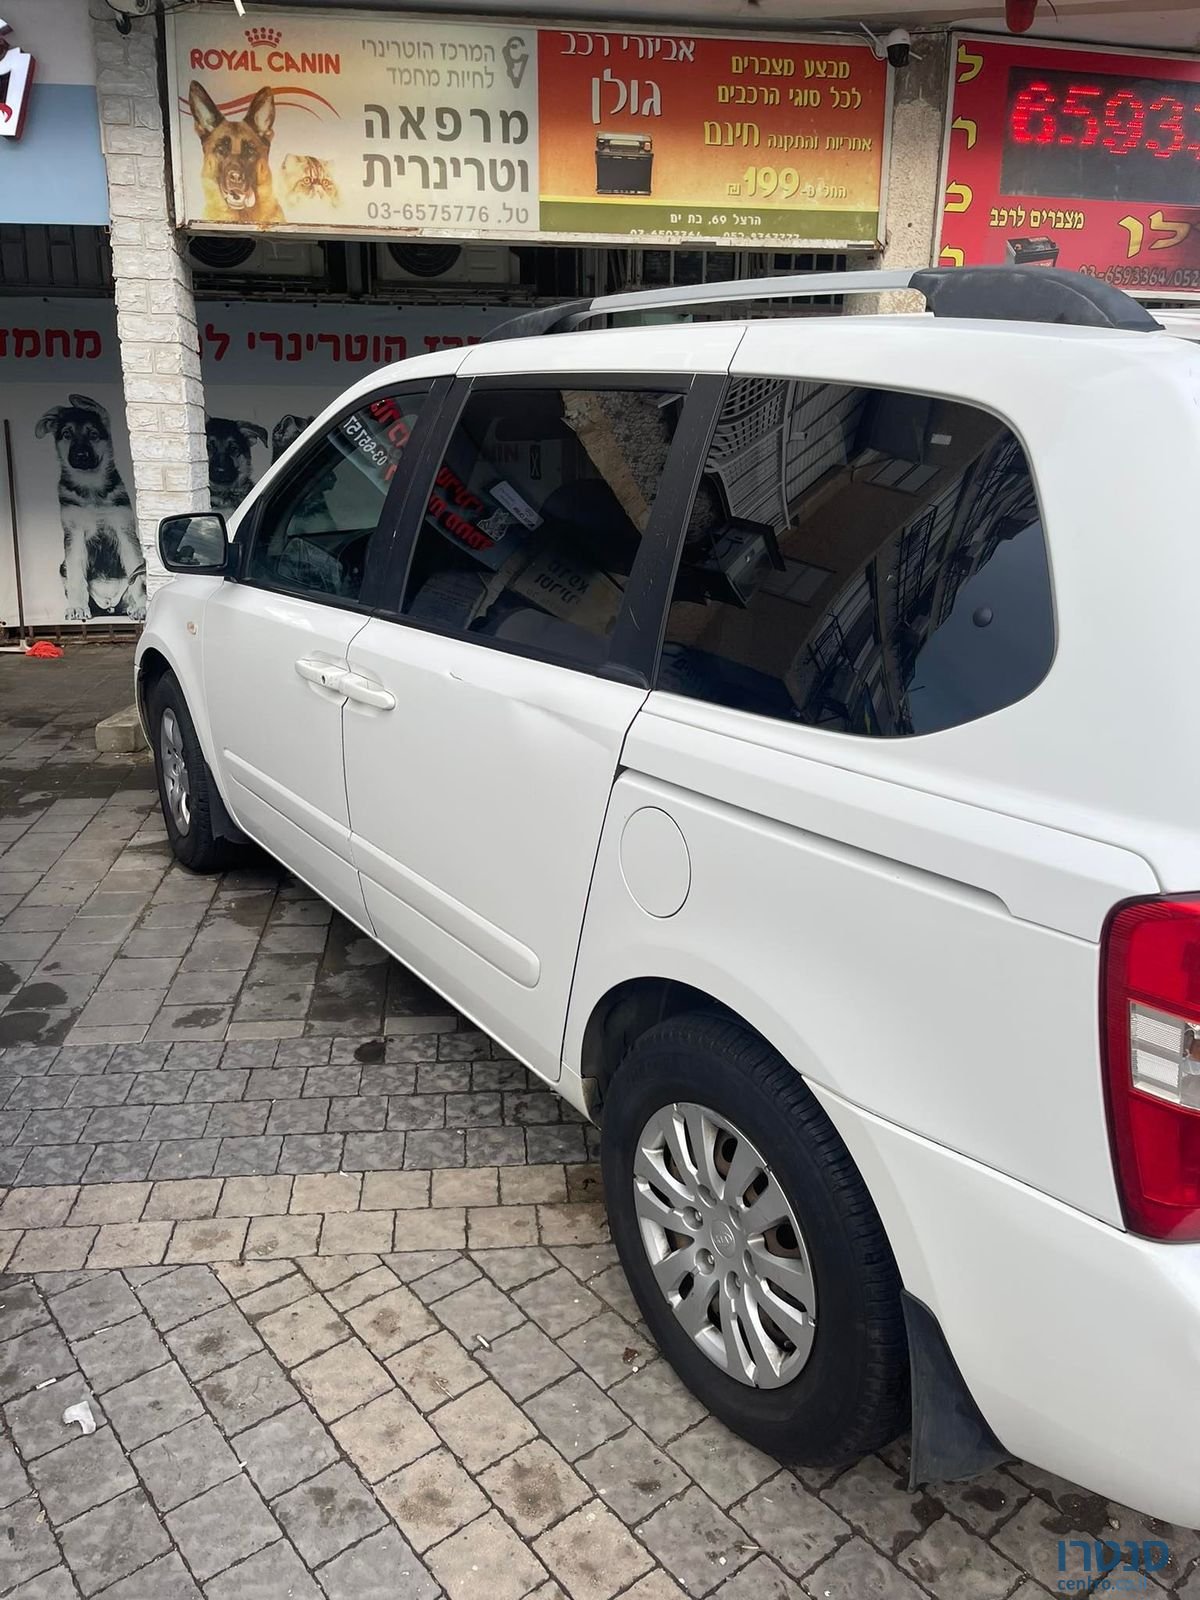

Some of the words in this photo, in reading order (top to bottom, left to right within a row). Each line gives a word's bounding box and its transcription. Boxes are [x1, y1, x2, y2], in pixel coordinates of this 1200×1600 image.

[361, 38, 434, 60] הוטרינרי
[440, 41, 496, 62] המרכז
[560, 32, 610, 57] רכב
[623, 36, 696, 63] אביזרי
[189, 48, 262, 73] ROYAL
[267, 51, 341, 75] CANIN
[731, 55, 795, 77] מצברים
[803, 58, 851, 79] מבצע
[386, 66, 440, 86] מחמד
[446, 67, 495, 89] לחיות
[591, 68, 663, 125] גולן
[717, 85, 780, 106] הרכבים
[788, 87, 821, 108] סוגי
[829, 87, 862, 110] לכל
[363, 104, 529, 145] מרפאה
[1012, 81, 1200, 160] 6593
[704, 121, 761, 148] חינם
[767, 133, 820, 151] והתקנה
[825, 135, 873, 152] אחריות
[363, 153, 530, 193] וטרינרית
[367, 201, 490, 223] 03-6575776
[497, 202, 530, 224] טל.
[670, 213, 682, 224] ים
[687, 213, 703, 225] בת
[732, 213, 762, 227] הרצל
[989, 205, 1027, 228] לרכב
[1028, 210, 1085, 230] מצברים
[247, 332, 406, 362] הוטרינרי
